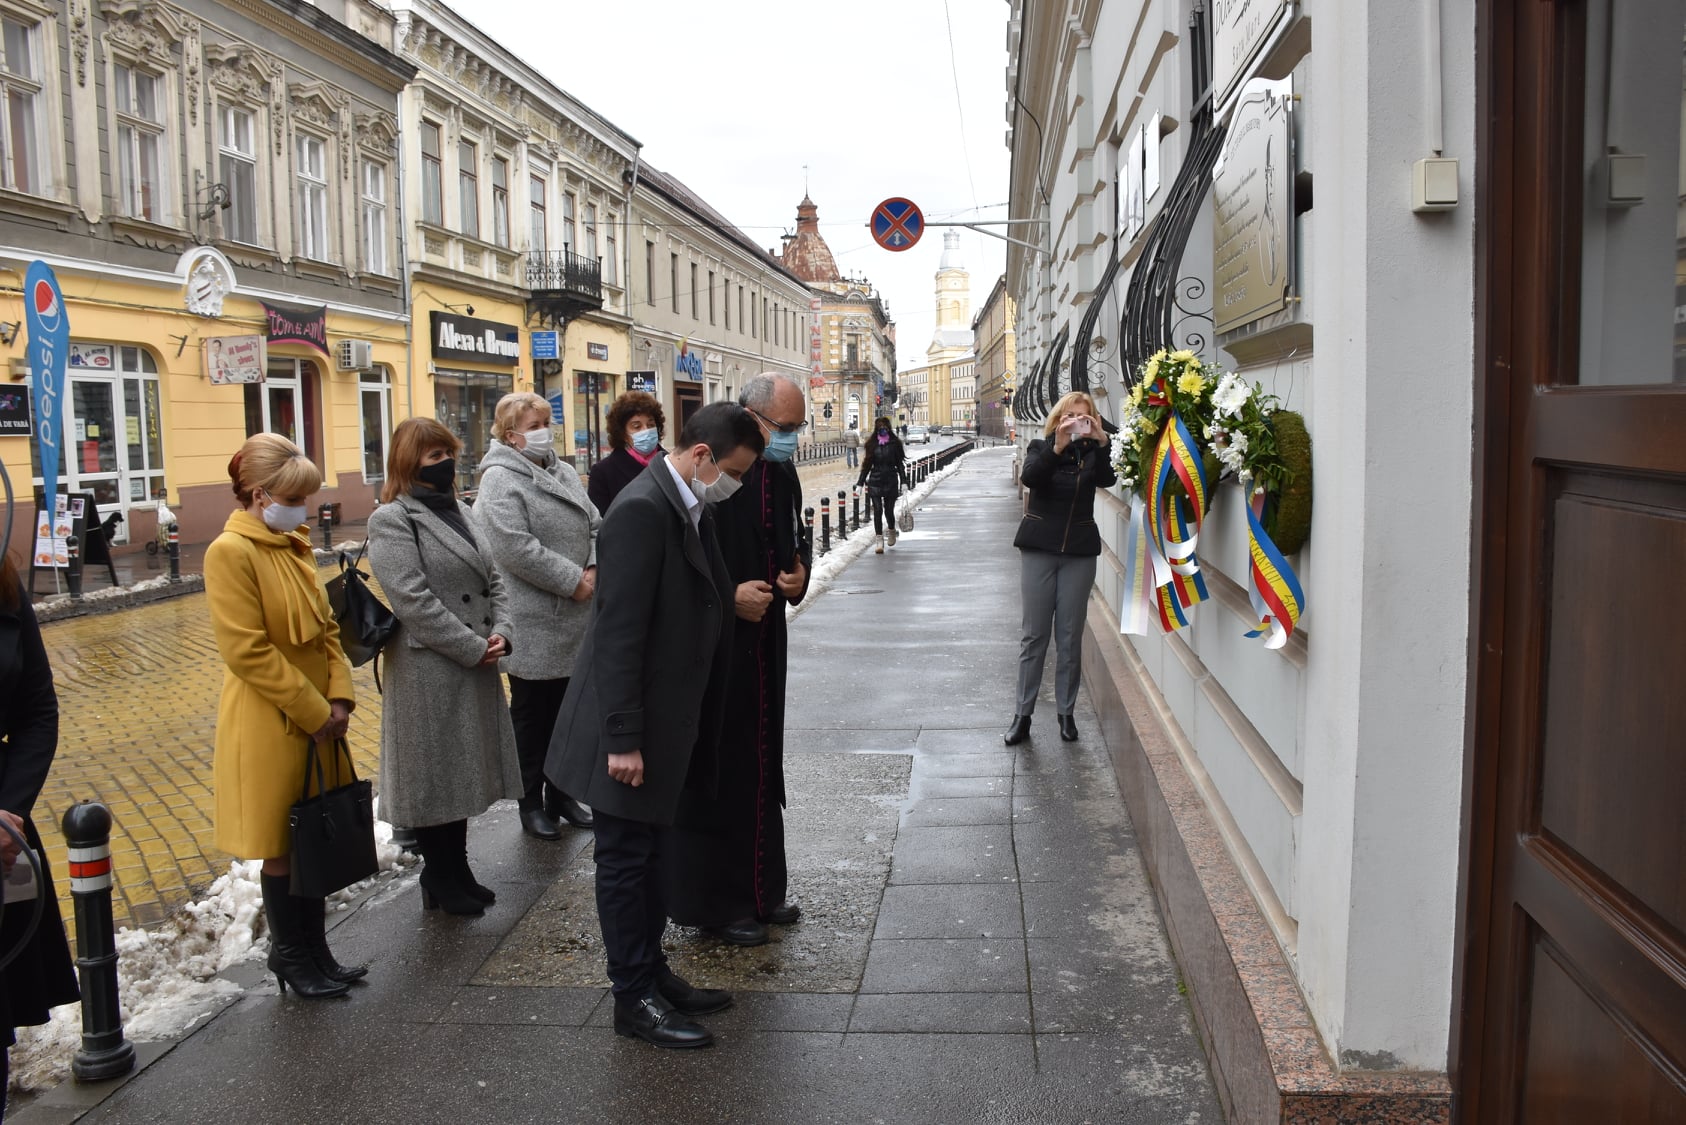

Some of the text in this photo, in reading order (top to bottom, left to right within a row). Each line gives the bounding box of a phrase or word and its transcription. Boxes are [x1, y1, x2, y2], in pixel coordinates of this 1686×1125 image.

[438, 321, 475, 352] Alexa
[476, 336, 485, 353] &
[38, 336, 57, 448] pepsi
